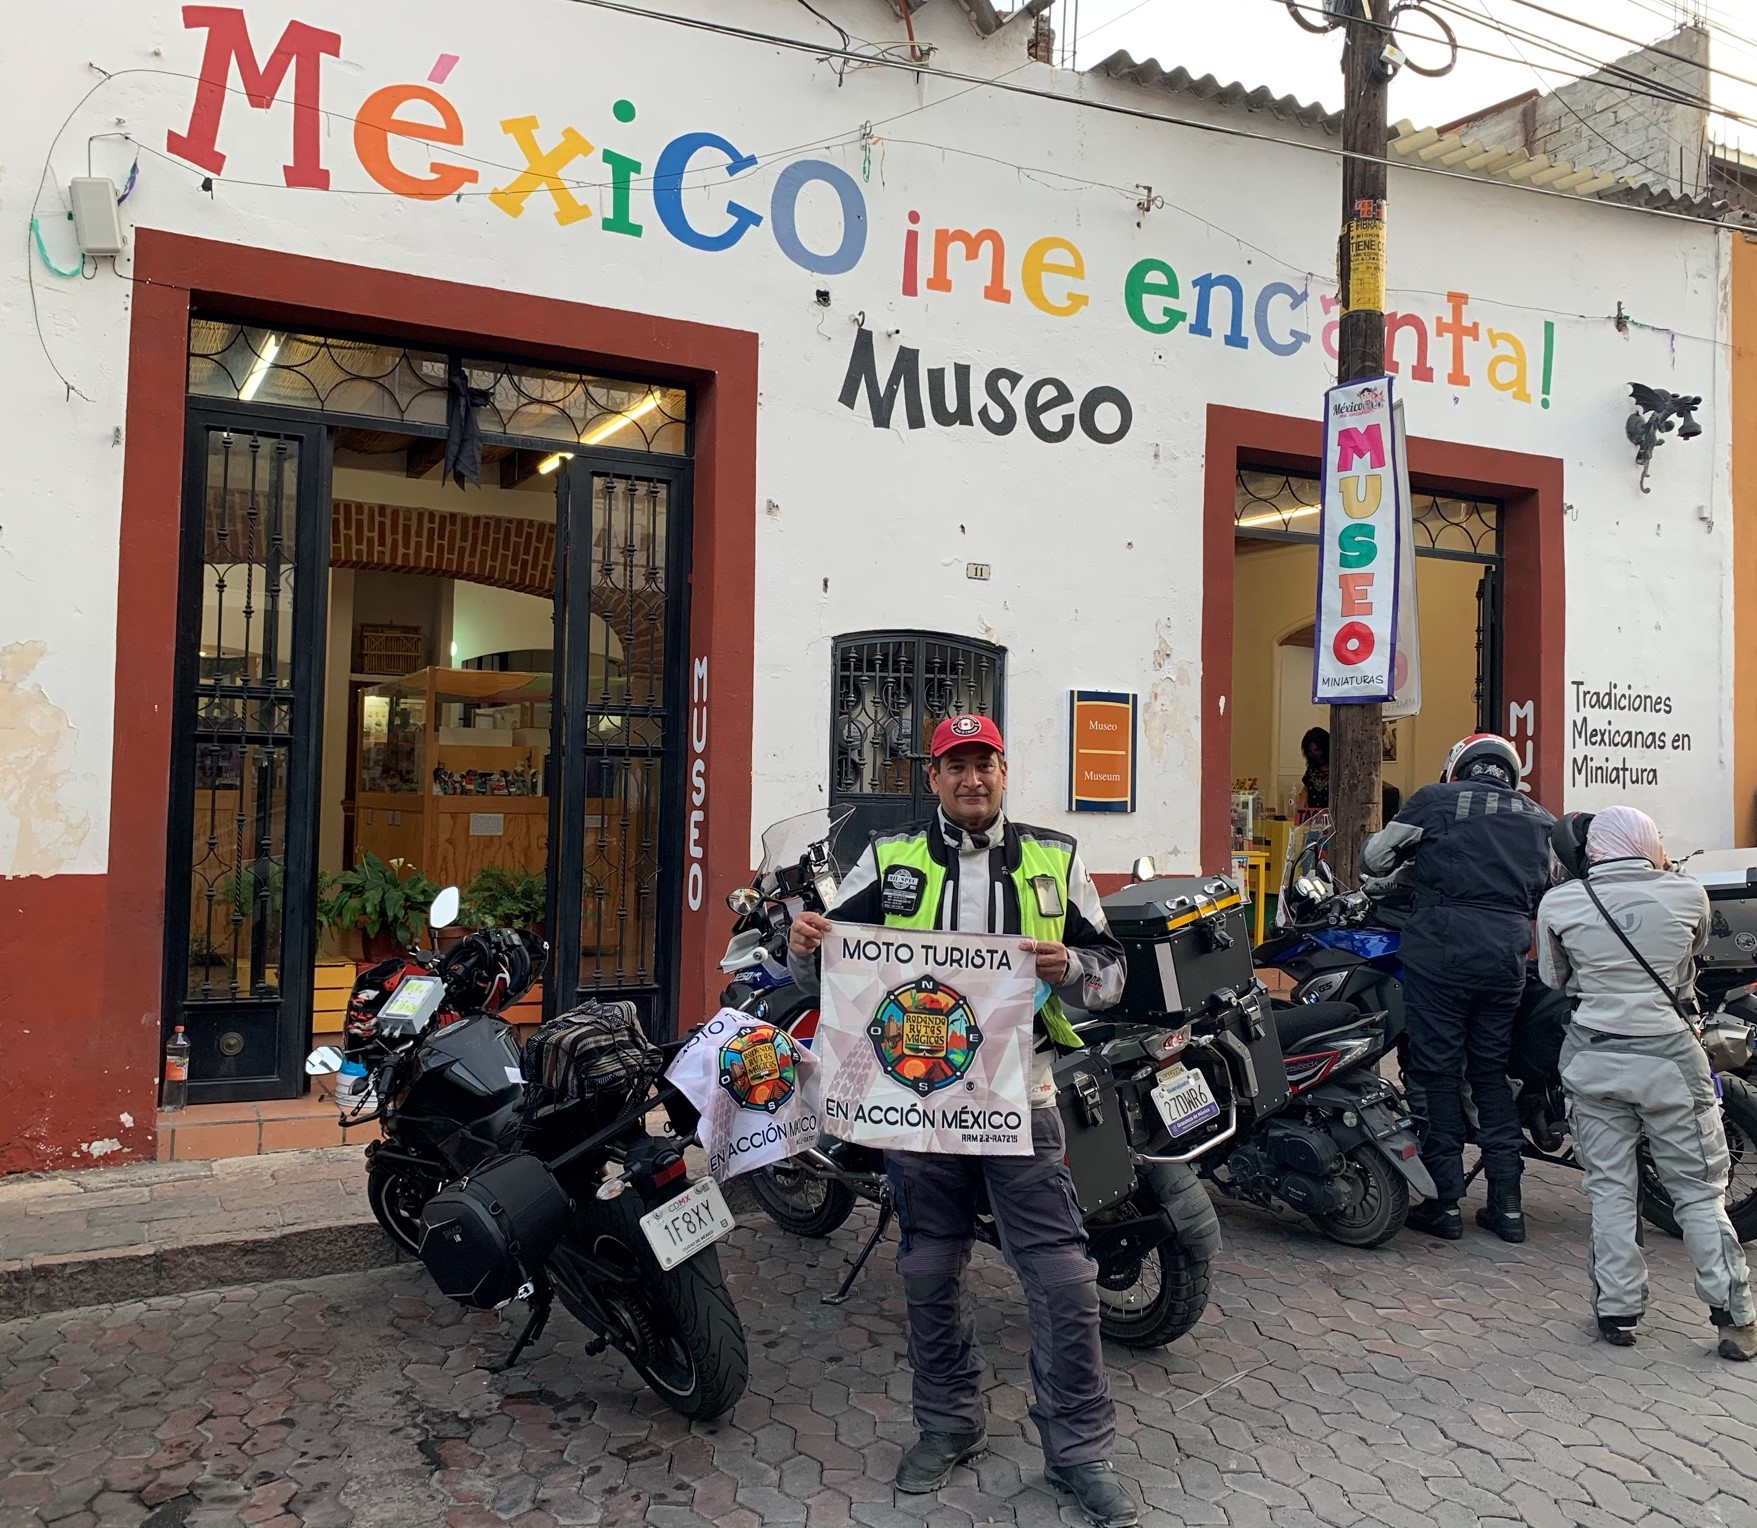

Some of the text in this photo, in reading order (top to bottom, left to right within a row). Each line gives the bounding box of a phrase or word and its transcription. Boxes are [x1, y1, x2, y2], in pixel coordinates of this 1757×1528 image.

[1350, 239, 1376, 253] TIENE
[837, 327, 1135, 445] Museo
[1332, 423, 1386, 665] MUSEO
[974, 566, 984, 577] 11
[1321, 675, 1384, 688] MINIATURAS
[1571, 681, 1672, 714] Tradiciones
[1089, 720, 1118, 731] Museo
[1572, 716, 1691, 751] Mexicanas en
[688, 655, 708, 912] MUSEO
[1084, 770, 1121, 781] Museum
[1572, 754, 1658, 789] Miniatura
[842, 938, 1012, 971] MOTO TURISTA
[922, 980, 933, 989] N
[1318, 981, 1333, 992] GS
[826, 1098, 1022, 1130] EN ACCIÓN MÉXICO
[1164, 1084, 1208, 1121] 27DWR6
[710, 1152, 726, 1173] EN
[728, 1122, 789, 1160] ACCIÓN
[961, 1133, 978, 1143] RRM
[668, 1194, 692, 1213] CDMX
[664, 1199, 715, 1246] 1F8XY
